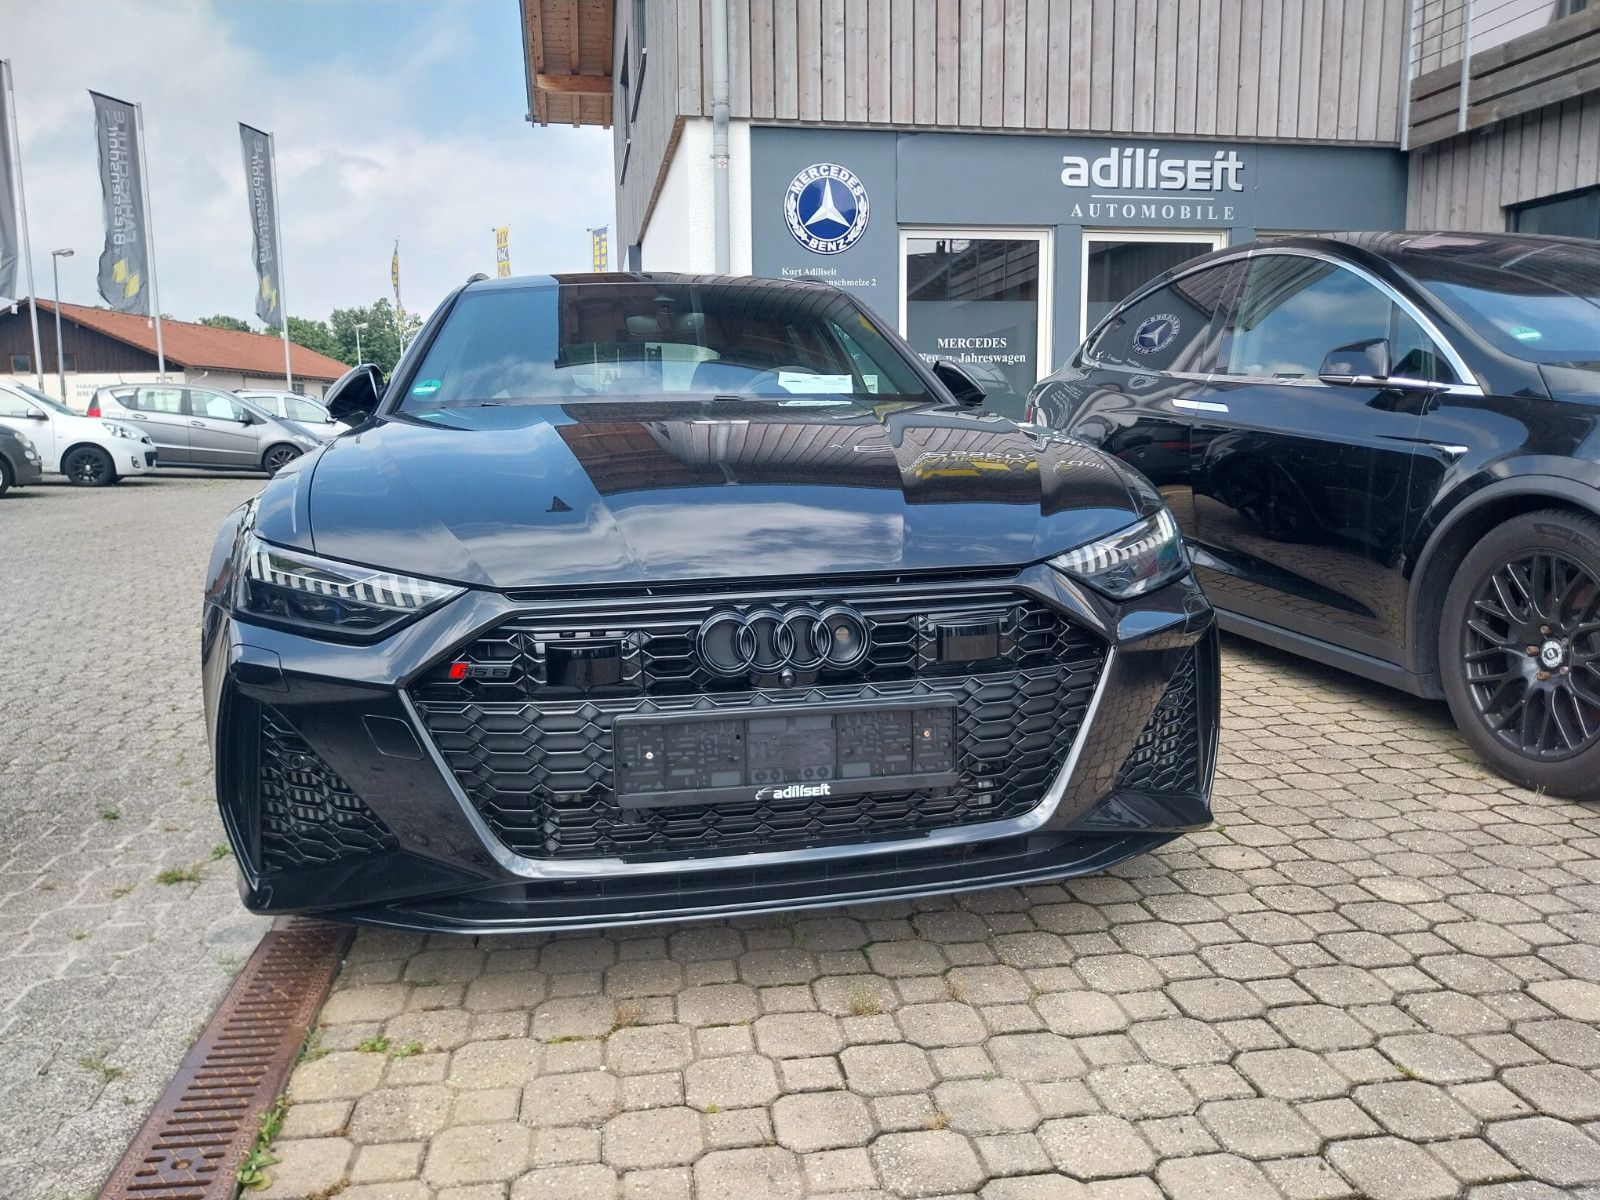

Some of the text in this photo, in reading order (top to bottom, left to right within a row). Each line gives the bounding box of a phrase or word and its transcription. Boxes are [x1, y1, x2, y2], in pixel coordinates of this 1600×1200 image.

[790, 165, 864, 195] MERCEDES
[1070, 203, 1235, 220] AUTOMOBILE
[808, 238, 847, 252] BENZ
[781, 267, 802, 276] Kurt
[871, 278, 877, 287] 2
[936, 337, 1008, 349] MERCEDES
[958, 352, 1026, 365] Jahreswagen
